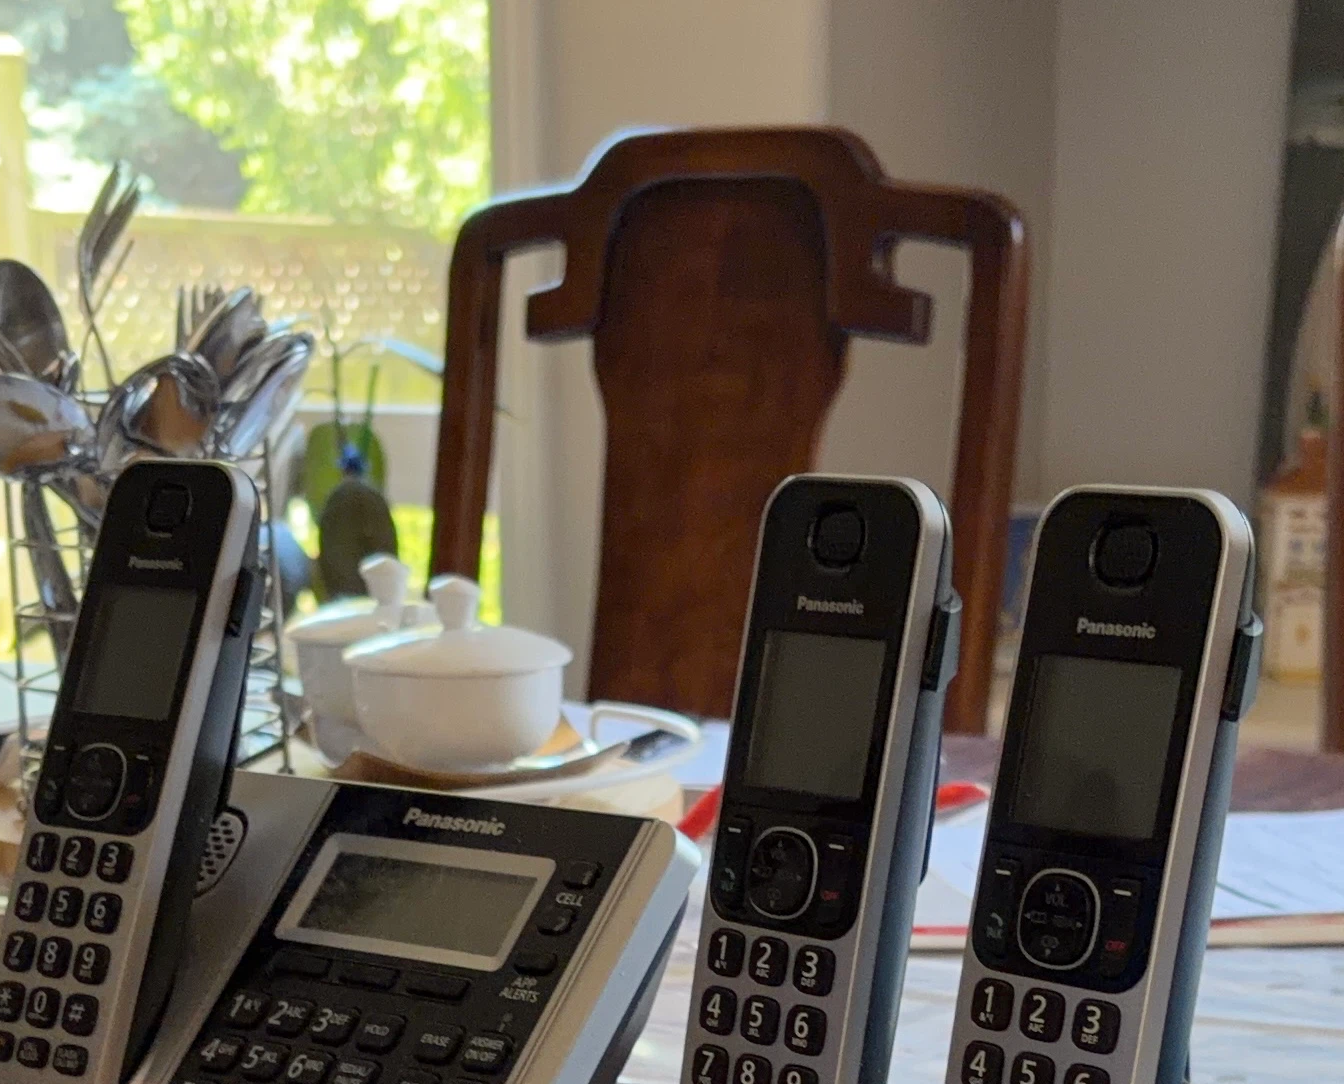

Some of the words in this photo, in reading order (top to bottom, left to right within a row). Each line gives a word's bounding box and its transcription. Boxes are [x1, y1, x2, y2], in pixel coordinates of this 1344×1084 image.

[127, 555, 183, 570] Panasonic
[796, 595, 865, 615] Panasonic
[1076, 616, 1157, 640] Panasonic
[403, 807, 506, 836] Panasonic
[37, 836, 45, 857] 1
[67, 839, 82, 862] 2
[104, 844, 119, 868] 3
[22, 886, 34, 908] 4
[55, 890, 70, 912] 5
[93, 896, 107, 920] 6
[556, 892, 583, 907] CELL
[12, 936, 24, 957] 7
[44, 941, 58, 964] 8
[82, 947, 95, 969] 9
[718, 935, 728, 960] 1
[756, 942, 772, 968] 2
[802, 951, 819, 978] 3
[512, 977, 537, 989] APP
[34, 991, 47, 1013] 0
[230, 995, 245, 1017] 1
[499, 987, 540, 1003] ALERTS
[707, 993, 721, 1018] 4
[984, 986, 995, 1012] 1
[268, 1001, 288, 1025] 2
[312, 1008, 333, 1032] 3
[749, 1002, 764, 1028] 5
[1029, 994, 1047, 1023] 2
[1082, 1005, 1101, 1034] 3
[794, 1012, 809, 1038] 6
[201, 1038, 221, 1061] 4
[421, 1033, 451, 1048] ERASE
[1081, 1034, 1099, 1044] DEF
[241, 1046, 265, 1069] 5
[288, 1054, 307, 1078] 6
[701, 1050, 715, 1075] 7
[970, 1050, 986, 1077] 4
